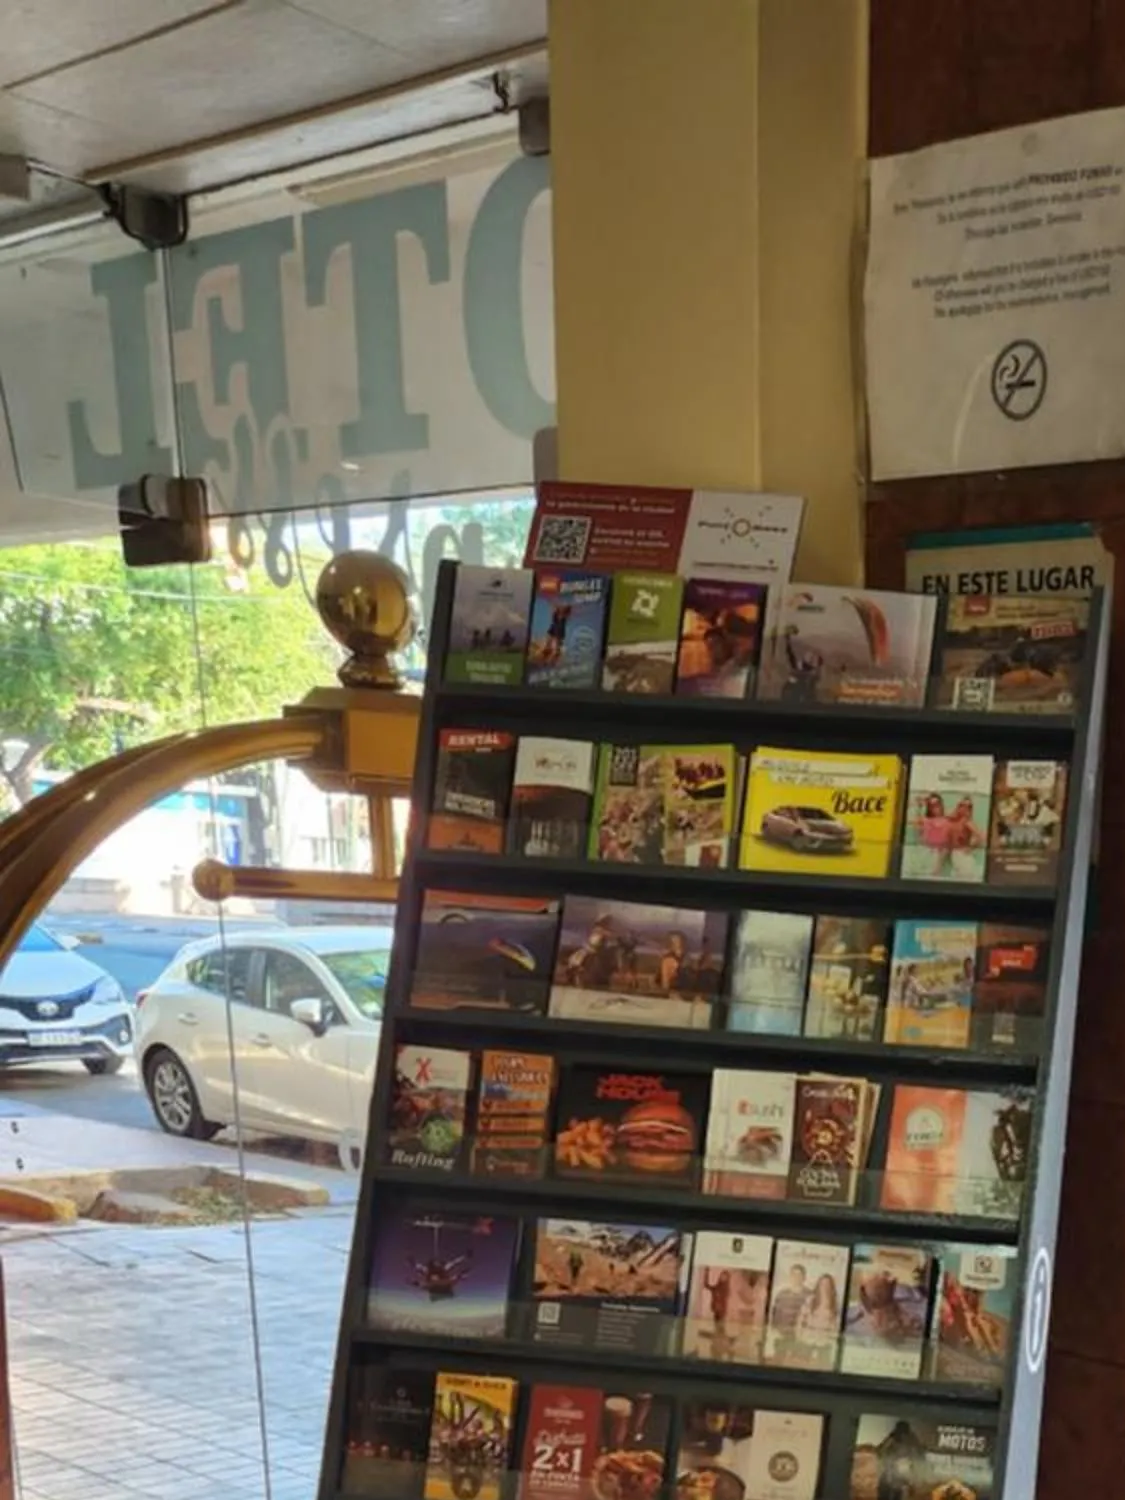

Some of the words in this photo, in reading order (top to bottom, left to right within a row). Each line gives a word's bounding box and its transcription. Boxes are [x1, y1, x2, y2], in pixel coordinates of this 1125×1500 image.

[922, 574, 949, 594] EN
[958, 570, 1008, 594] ESTE
[1017, 565, 1095, 592] LUGAR
[448, 732, 500, 747] RENTAL
[392, 1149, 455, 1172] Rafting
[939, 1433, 986, 1452] MOTOS
